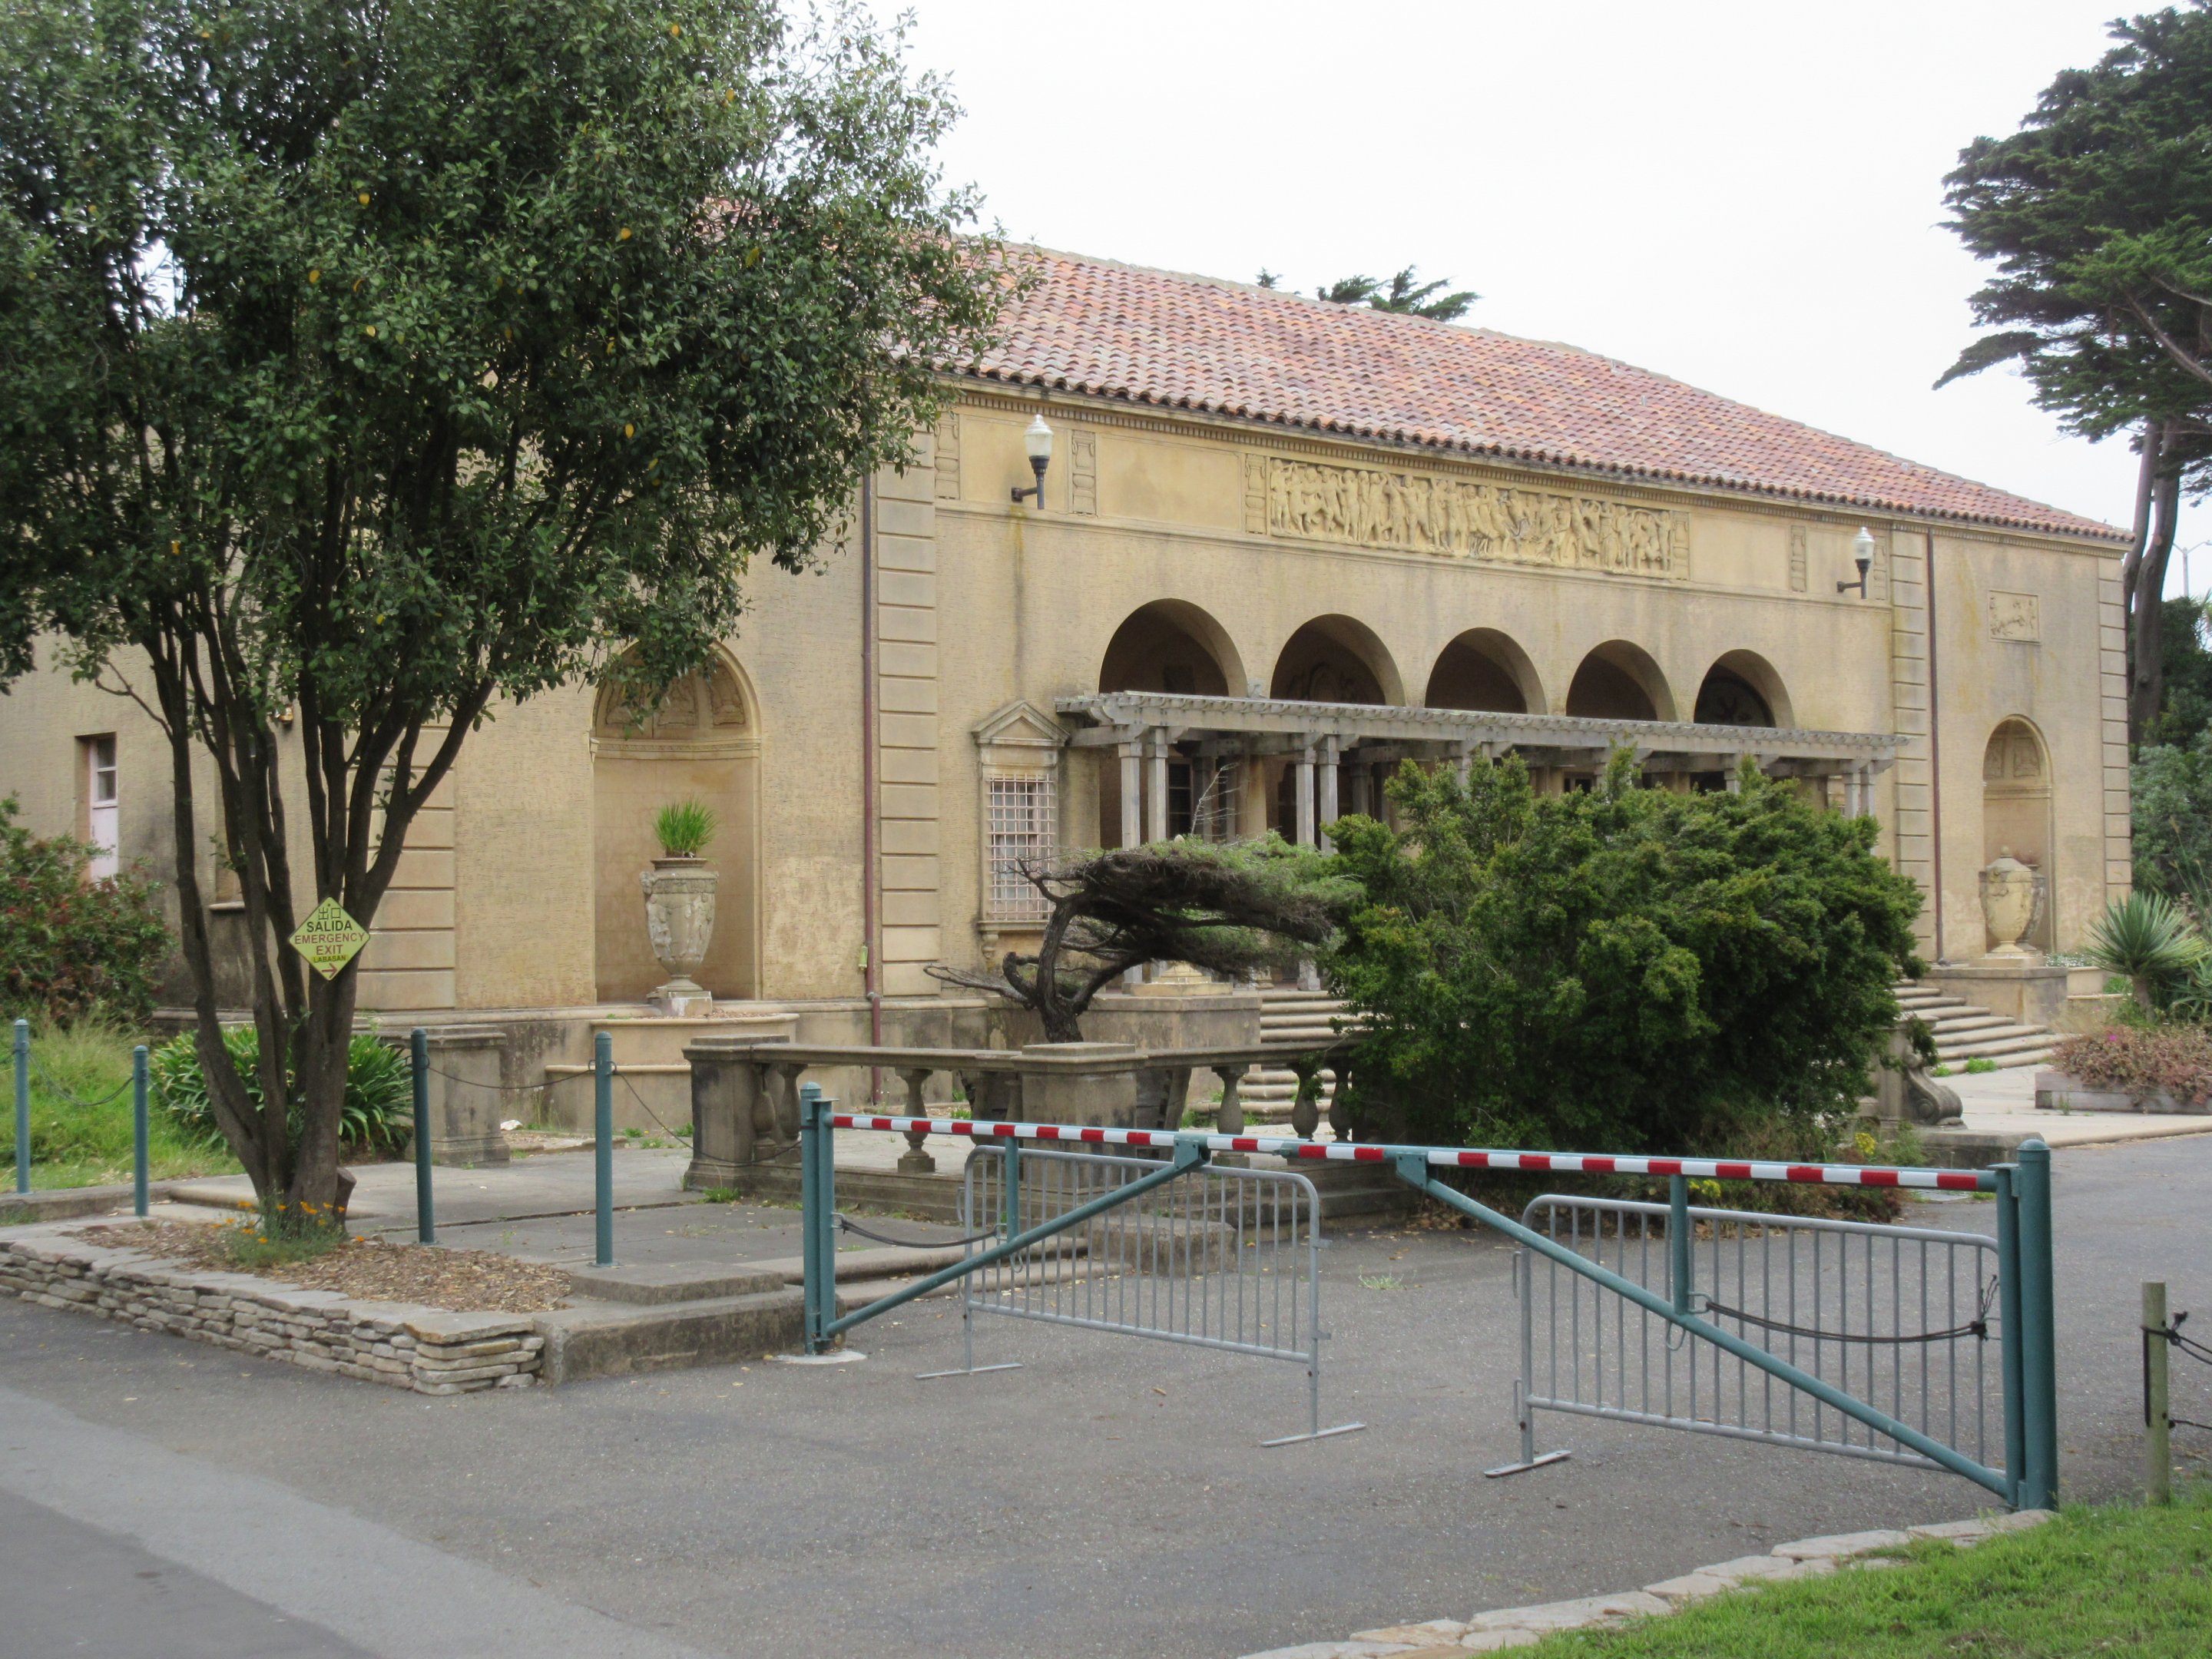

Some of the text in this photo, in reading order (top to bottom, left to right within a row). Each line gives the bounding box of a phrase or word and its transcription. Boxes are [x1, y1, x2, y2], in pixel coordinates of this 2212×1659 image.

[319, 907, 341, 920] 出口
[306, 920, 353, 932] SALIDA
[294, 932, 365, 944] EMERGENCY
[316, 945, 343, 955] EXIT
[313, 955, 346, 963] LABASAN
